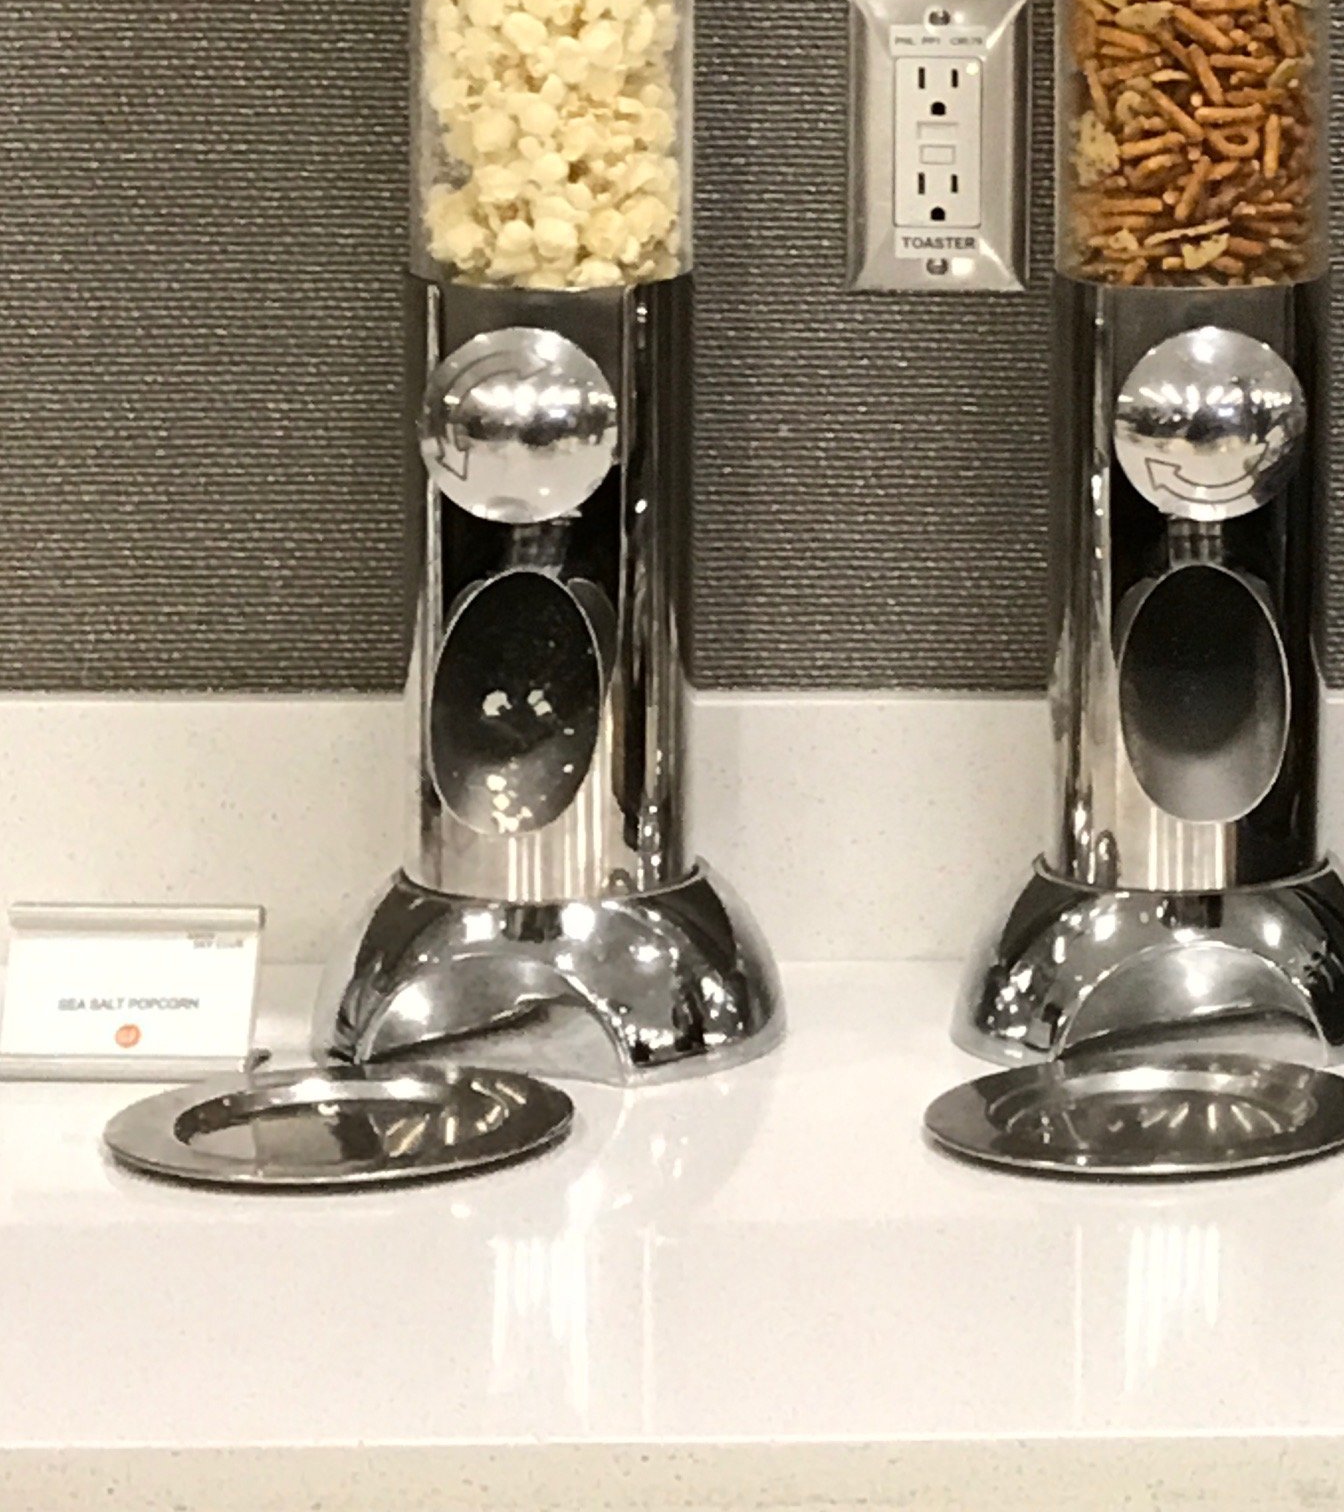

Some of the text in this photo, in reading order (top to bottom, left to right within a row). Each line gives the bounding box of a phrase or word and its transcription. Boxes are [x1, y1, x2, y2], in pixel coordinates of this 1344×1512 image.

[902, 236, 976, 250] TOASTER
[57, 998, 200, 1011] SEA SALT POPCORN
